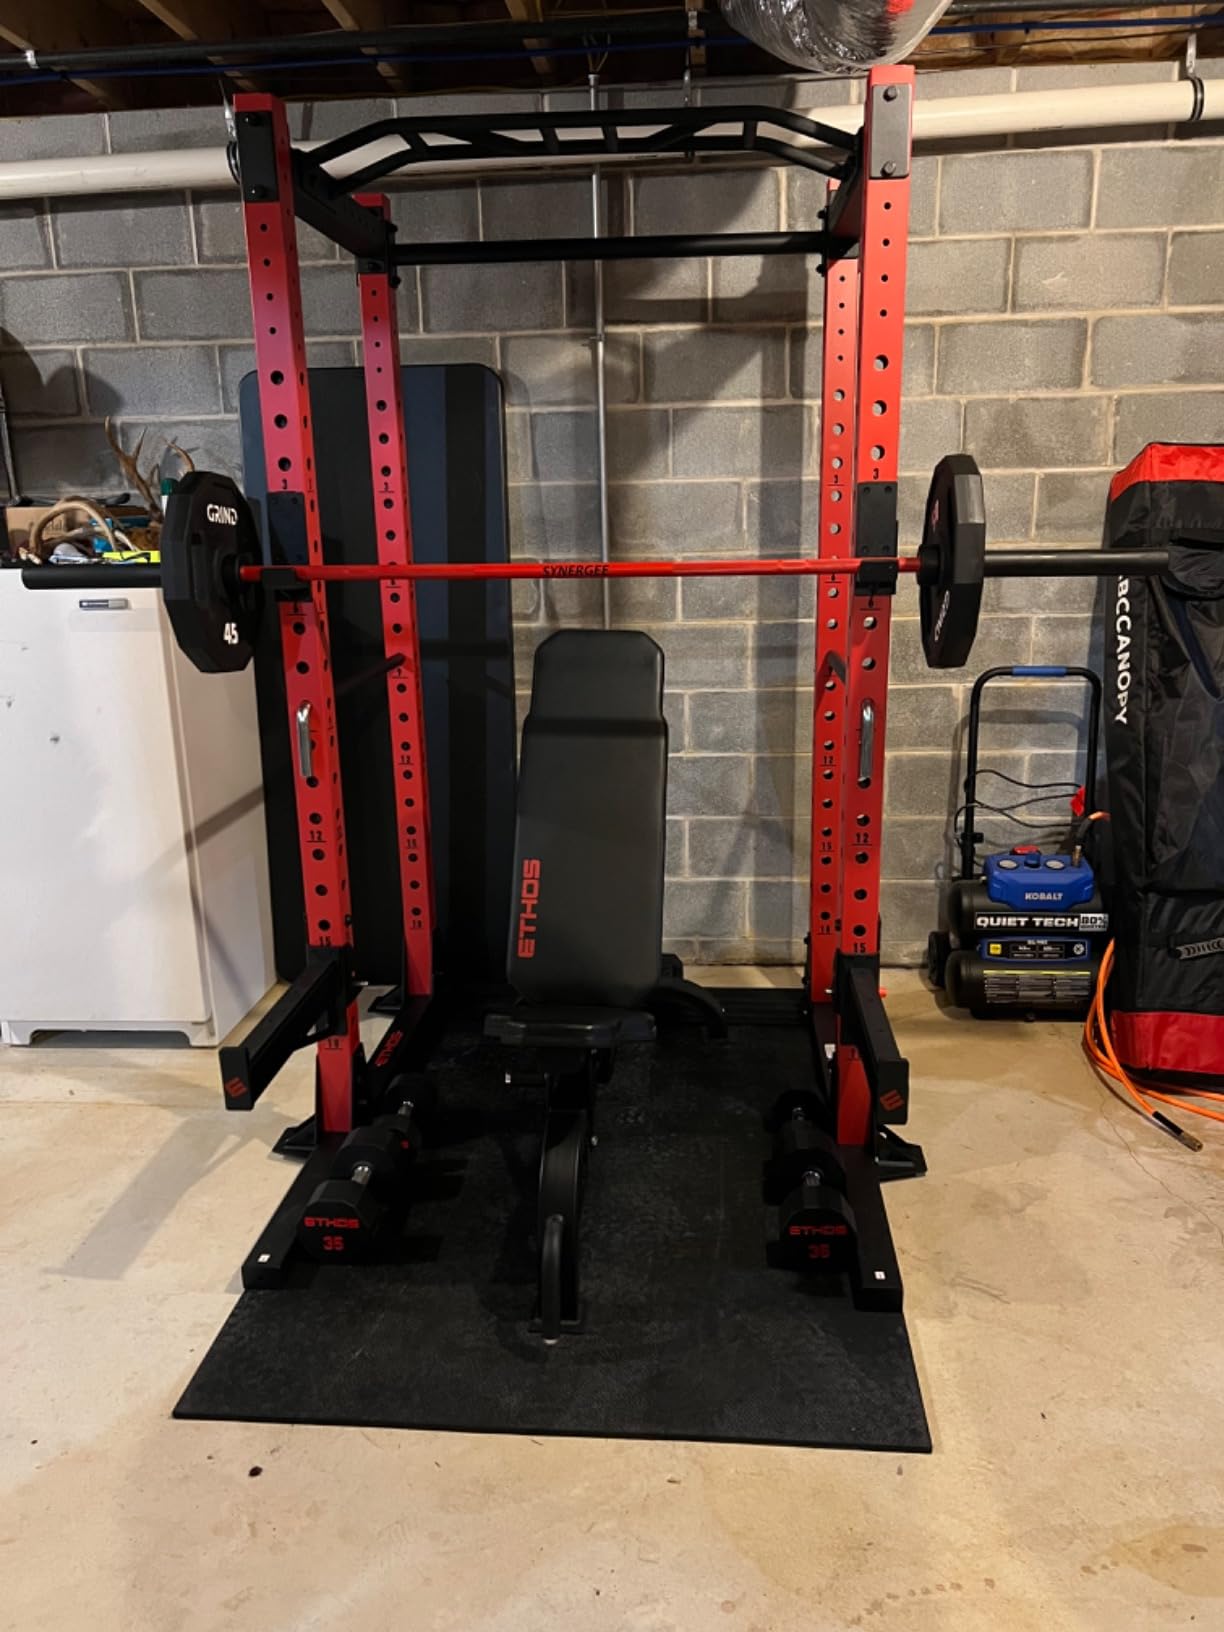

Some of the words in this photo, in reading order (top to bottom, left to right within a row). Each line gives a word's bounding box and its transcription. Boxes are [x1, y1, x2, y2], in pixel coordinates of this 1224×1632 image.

[873, 468, 880, 481] 3
[206, 503, 239, 526] GRIND
[543, 564, 609, 578] SYNERGEE
[223, 622, 240, 645] 45
[1114, 575, 1132, 725] BCCANOPY
[309, 830, 323, 842] 12
[855, 833, 869, 844] 12
[1024, 892, 1063, 901] KOBALT
[518, 859, 541, 958] ETHOS
[976, 916, 1029, 928] QUIET
[1032, 917, 1079, 928] TECH
[853, 942, 866, 953] 15
[304, 1217, 359, 1229] ETHOS
[789, 1225, 848, 1236] ETHOS
[323, 1236, 344, 1250] 35
